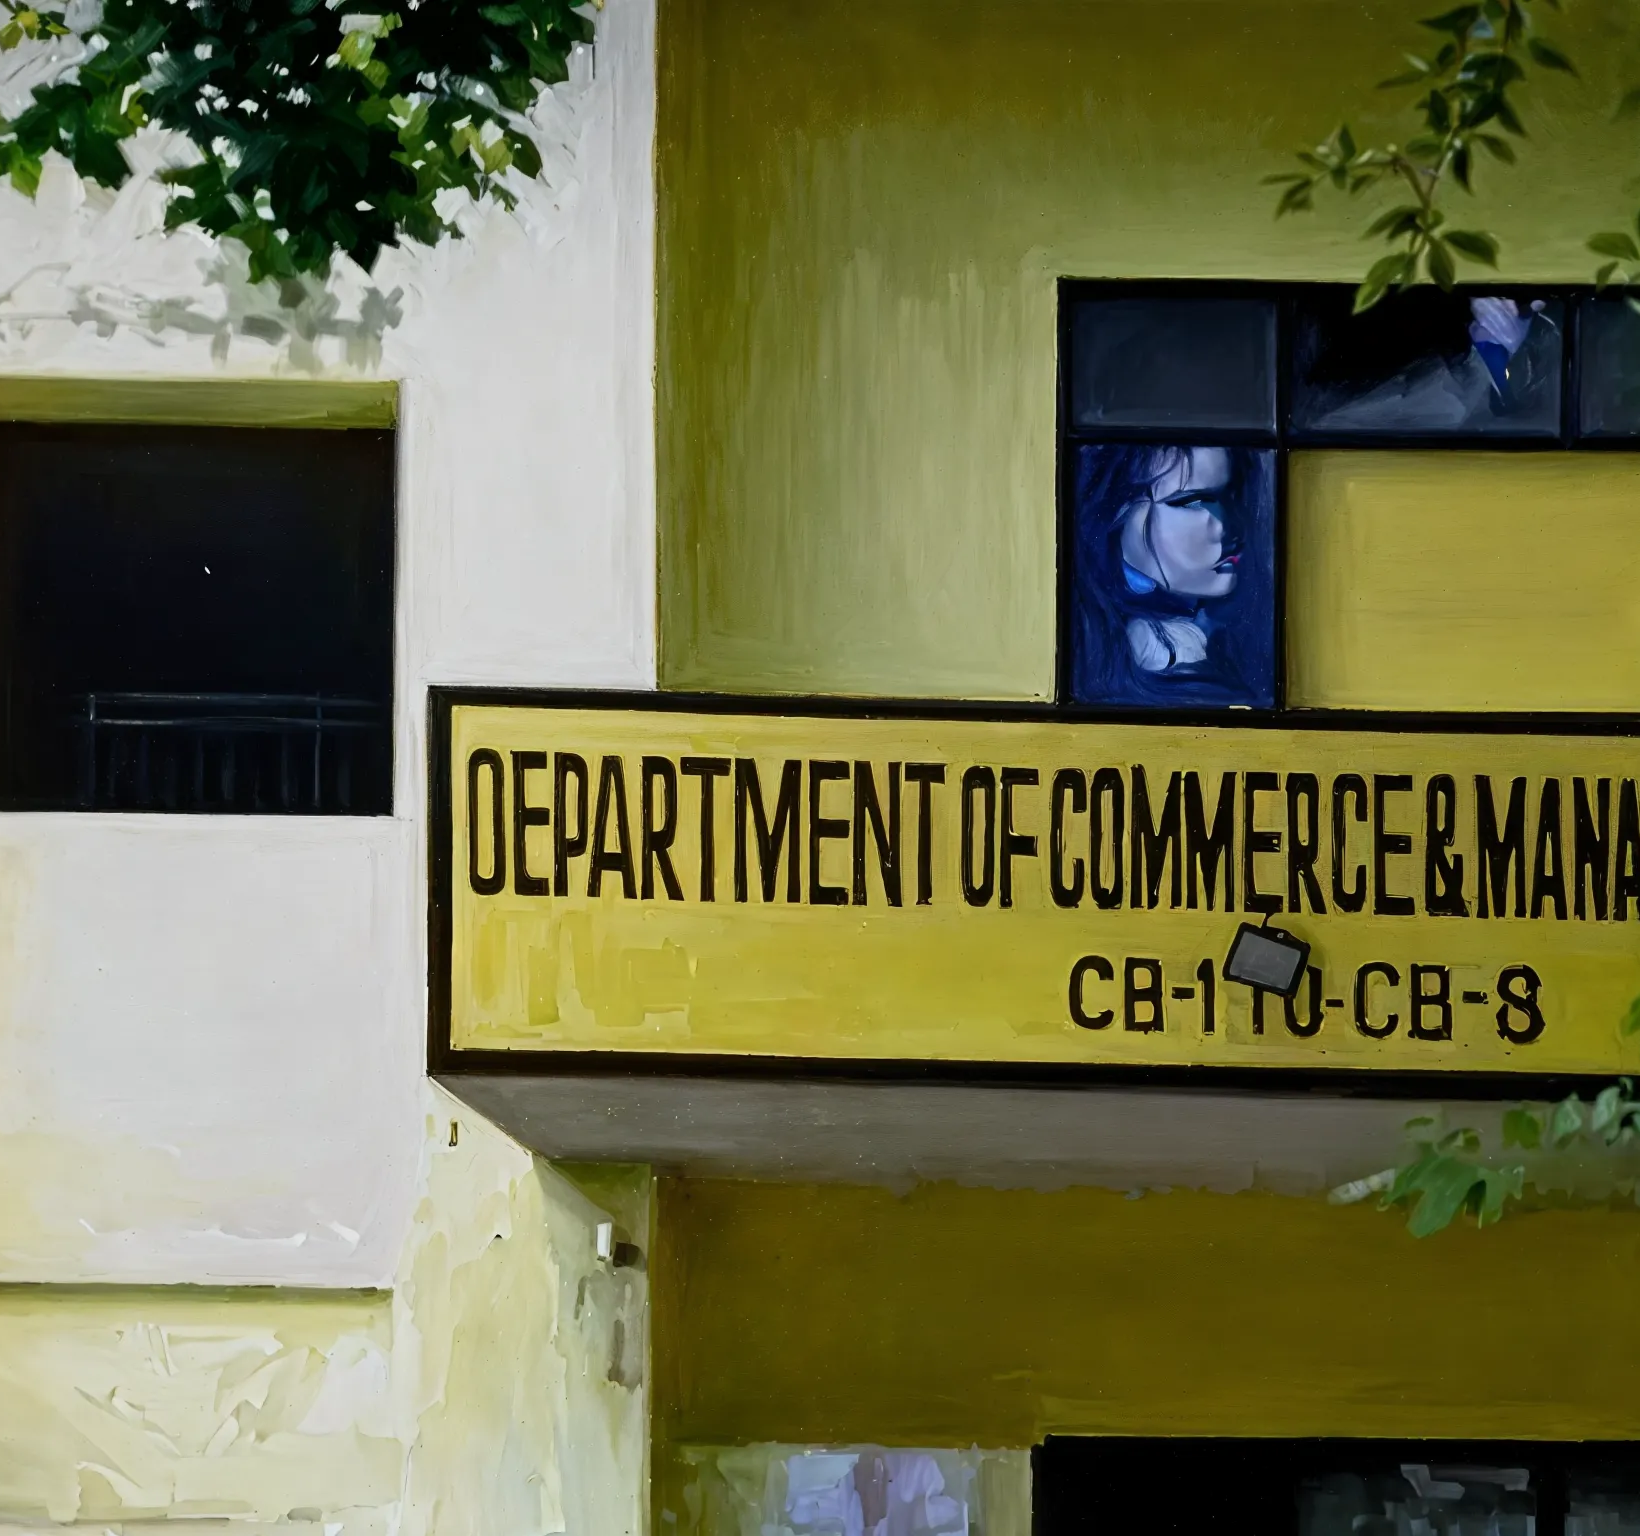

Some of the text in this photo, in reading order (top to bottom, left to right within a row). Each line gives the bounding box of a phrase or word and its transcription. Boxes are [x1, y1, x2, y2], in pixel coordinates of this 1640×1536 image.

[962, 766, 1038, 907] OF
[1050, 764, 1415, 910] COMMERCE
[1425, 774, 1471, 917] &
